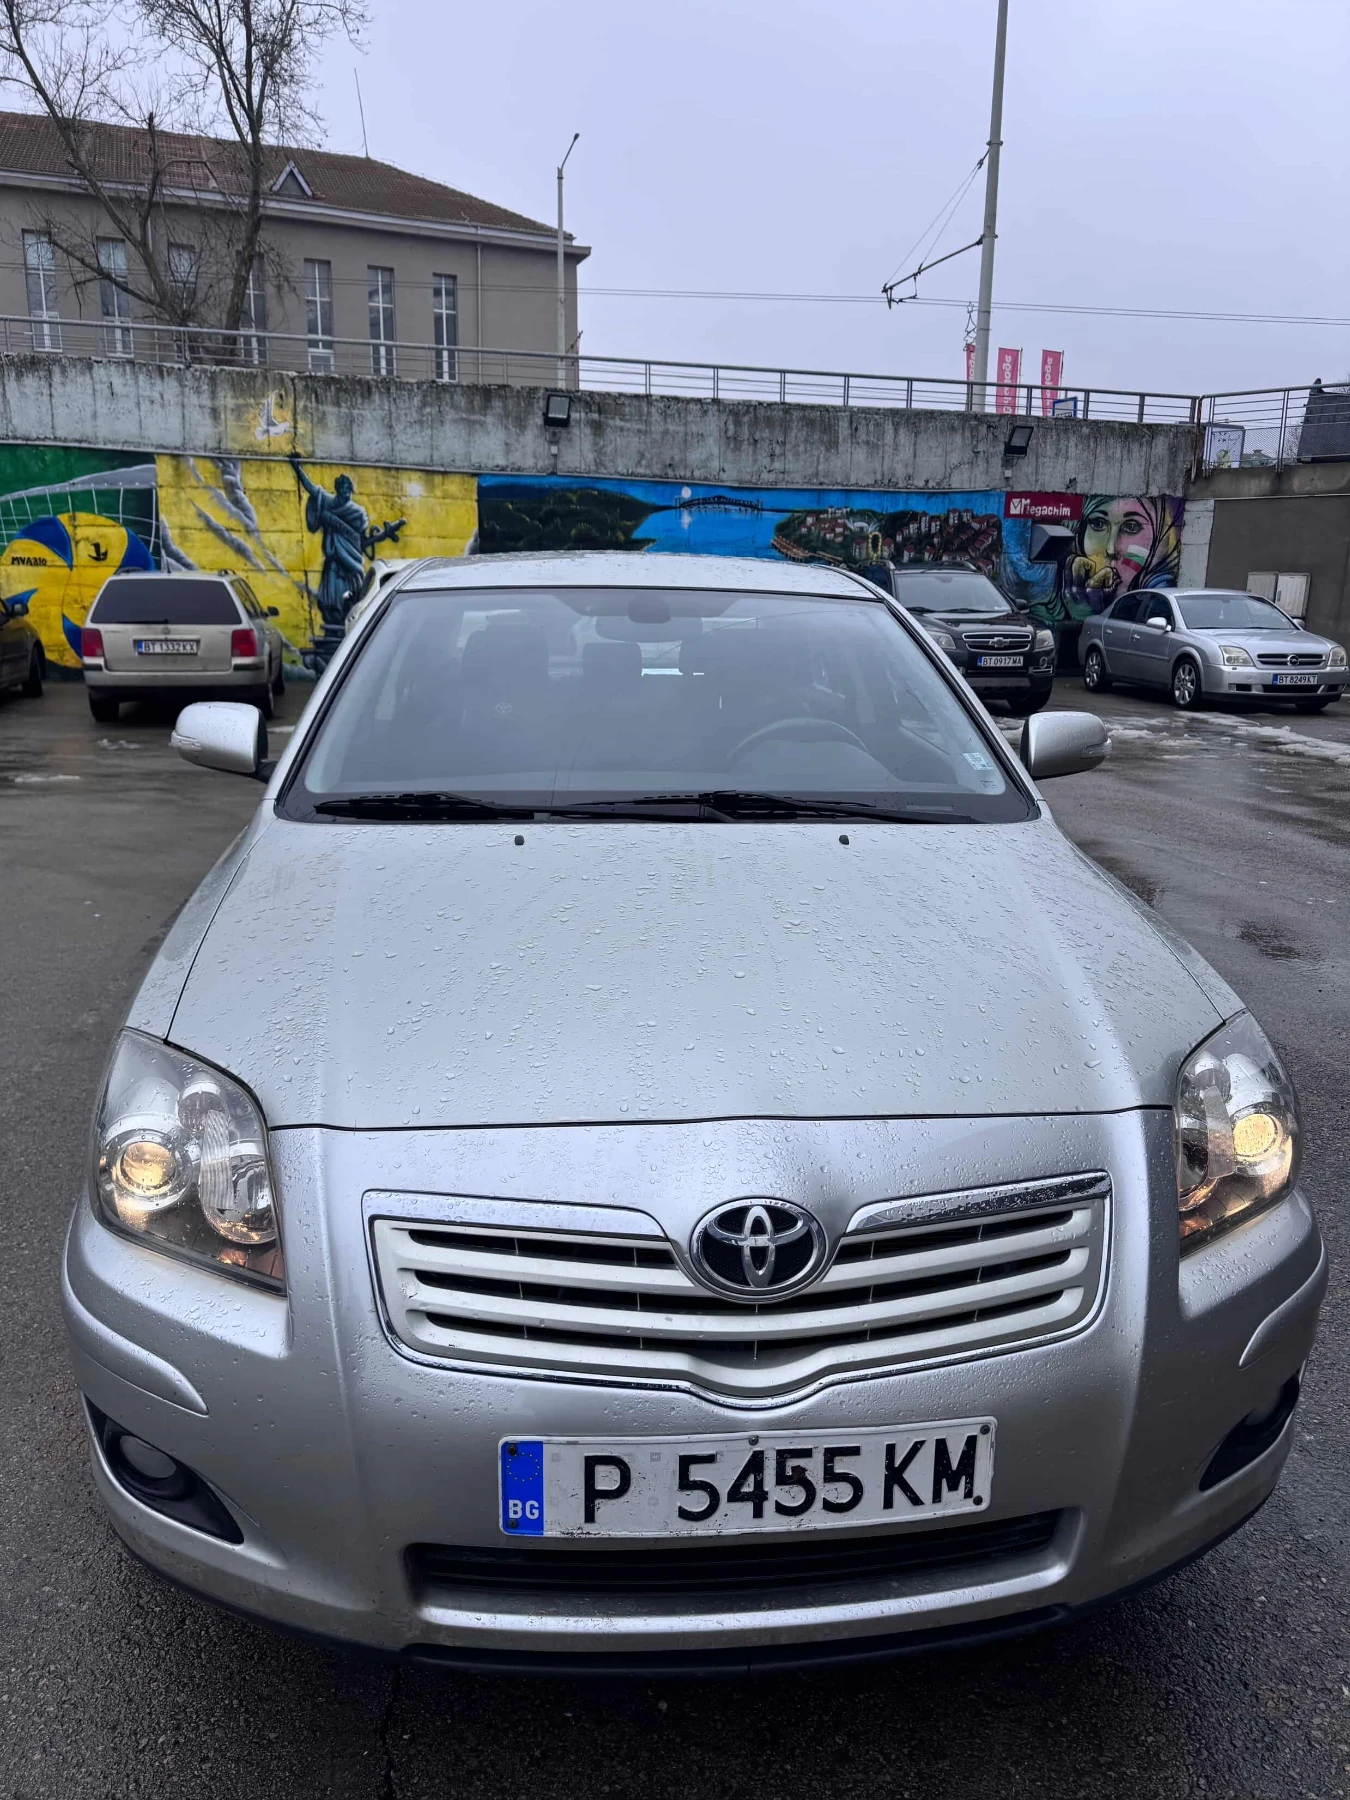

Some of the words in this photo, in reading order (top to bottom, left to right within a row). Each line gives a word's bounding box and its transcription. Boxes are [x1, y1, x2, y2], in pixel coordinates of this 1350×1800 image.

[1020, 498, 1070, 516] Megachim
[583, 1454, 632, 1524] P
[677, 1445, 864, 1522] 5455
[882, 1434, 978, 1510] KM
[508, 1500, 540, 1519] BG
